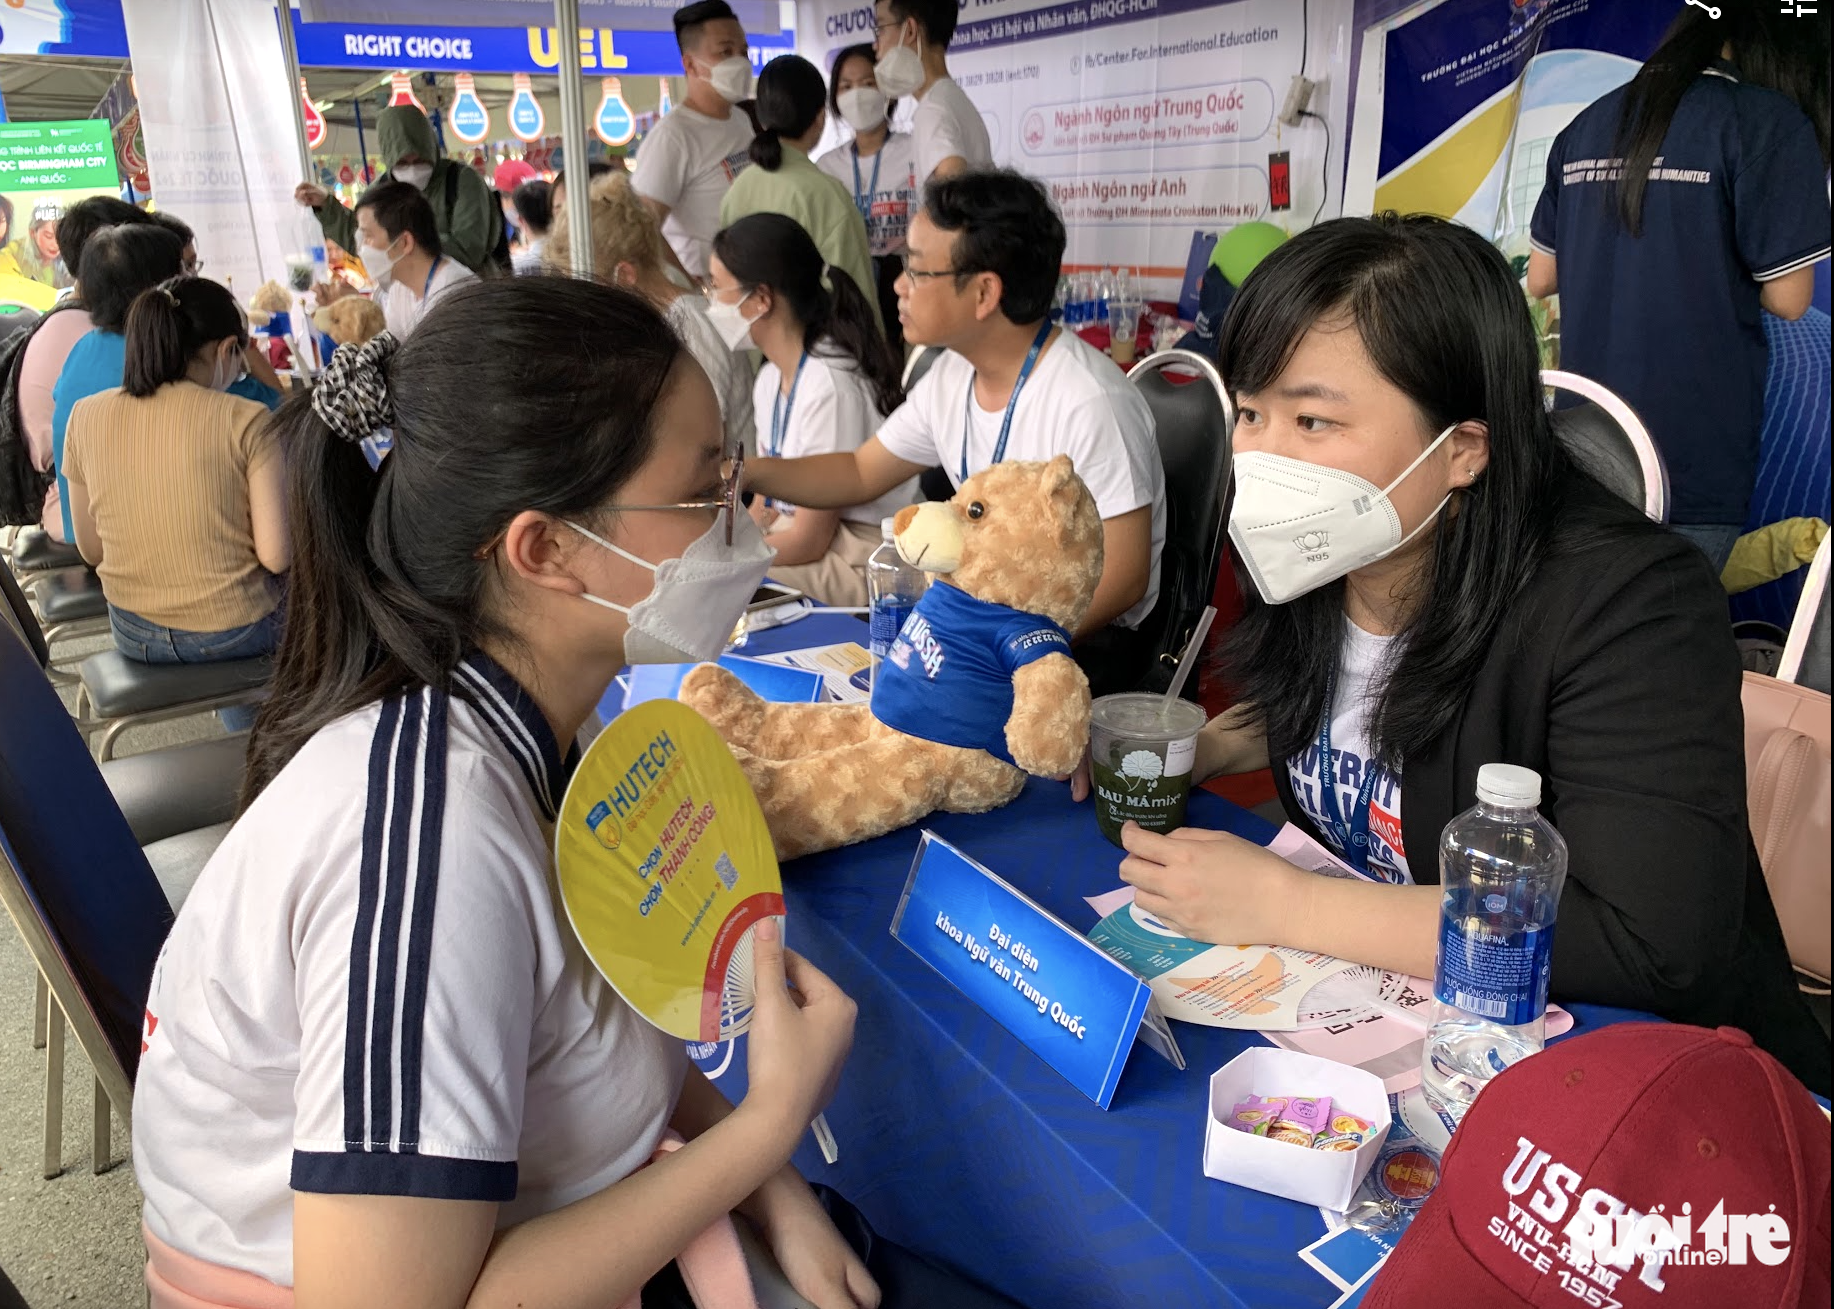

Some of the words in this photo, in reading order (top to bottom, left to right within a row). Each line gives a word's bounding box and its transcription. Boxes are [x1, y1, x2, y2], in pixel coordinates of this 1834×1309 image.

[344, 34, 401, 57] RIGHT
[405, 35, 473, 60] CHOICE
[527, 27, 628, 69] UEL
[1479, 41, 1499, 57] HỌC
[1054, 106, 1092, 131] Ngành
[1094, 103, 1130, 128] Ngôn
[1134, 98, 1160, 123] ngữ
[1162, 98, 1202, 119] Trung
[1206, 87, 1244, 114] Quốc
[68, 141, 93, 153] QUỐC
[18, 157, 85, 170] BIRMINGHAM
[86, 156, 107, 168] CITY
[1661, 168, 1711, 184] HUMANITIES
[20, 175, 38, 184] ANH
[40, 172, 67, 184] QUỐC
[1052, 183, 1089, 204] Ngành
[1091, 179, 1127, 203] Ngôn
[1131, 179, 1156, 201] ngữ
[1160, 177, 1186, 196] Anh
[1218, 203, 1237, 218] (Hoa
[1306, 553, 1330, 563] N95
[608, 729, 677, 818] HUTECH
[1323, 753, 1331, 788] TRƯỜNG
[1098, 785, 1123, 803] RAU
[1126, 794, 1150, 807] MÁ
[1360, 766, 1376, 806] University
[638, 845, 664, 880] CHỌN
[659, 795, 696, 851] HUTECH
[638, 881, 664, 918] CHỌN
[659, 843, 694, 885] THÀNH
[688, 799, 717, 844] CÔNG!
[989, 923, 1012, 952] Đại
[1011, 940, 1040, 972] diện
[1467, 931, 1507, 945] AQUAFINA
[935, 911, 963, 945] khoa
[963, 932, 990, 964] Ngữ
[989, 957, 1012, 982] văn
[1012, 970, 1049, 1014] Trung
[1050, 1001, 1087, 1040] Quốc
[1462, 985, 1485, 999] UỐNG
[1486, 989, 1509, 1002] ĐÓNG
[1508, 1201, 1622, 1292] VNU-HCM
[1488, 1215, 1553, 1276] SINCE
[1557, 1270, 1624, 1309] 1957
